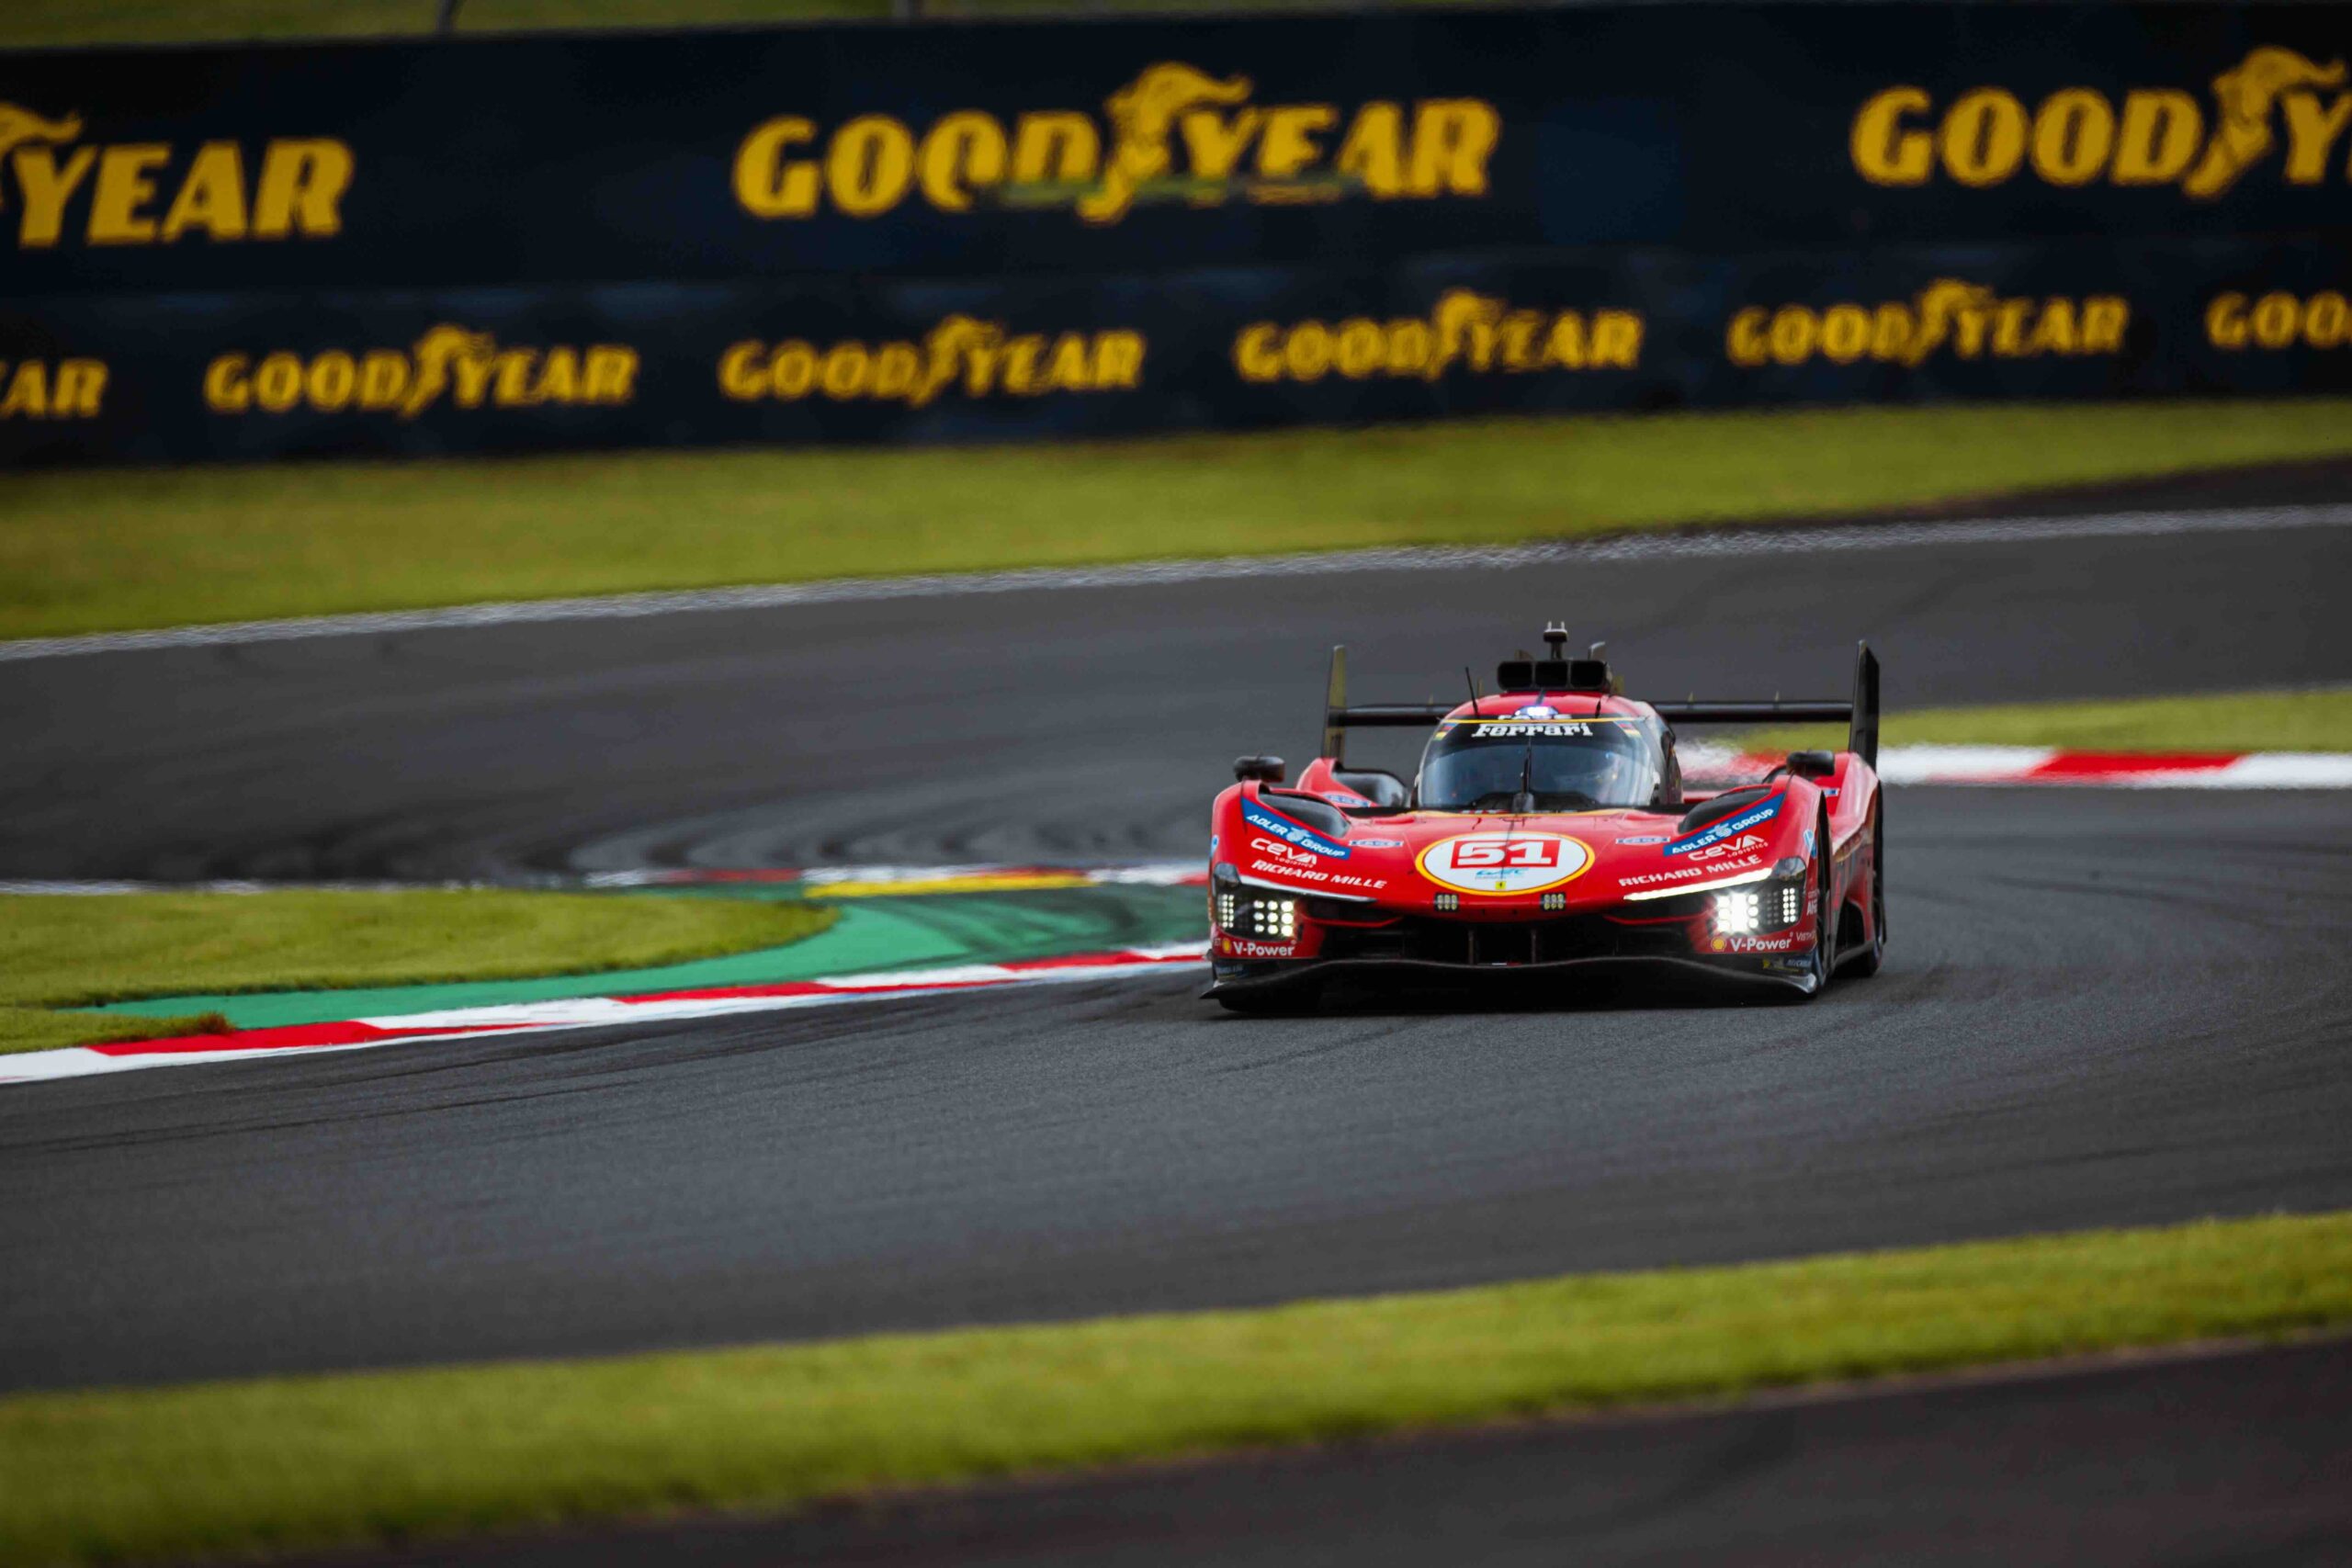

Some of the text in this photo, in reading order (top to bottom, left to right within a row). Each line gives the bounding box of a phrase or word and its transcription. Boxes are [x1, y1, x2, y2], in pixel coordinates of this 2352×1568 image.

[1850, 86, 2352, 186] GOODY
[733, 96, 1499, 221] GOODYEAR
[1234, 311, 1645, 382] GOODYEAR
[1726, 296, 2130, 366] GOODYEAR
[204, 345, 640, 413] GOODYEAR
[719, 330, 1146, 402] GOODYEAR
[1471, 722, 1593, 737] Ferrari
[1246, 814, 1346, 858] ADLER GROUP
[1457, 840, 1553, 865] 51
[1671, 835, 1716, 853] ADLER
[1732, 808, 1774, 830] GROUP
[1251, 860, 1387, 889] RICHARD MILLE
[1618, 854, 1762, 887] RICHARD MILLE
[1233, 942, 1295, 956] V-Power
[1730, 937, 1792, 952] V-Power
